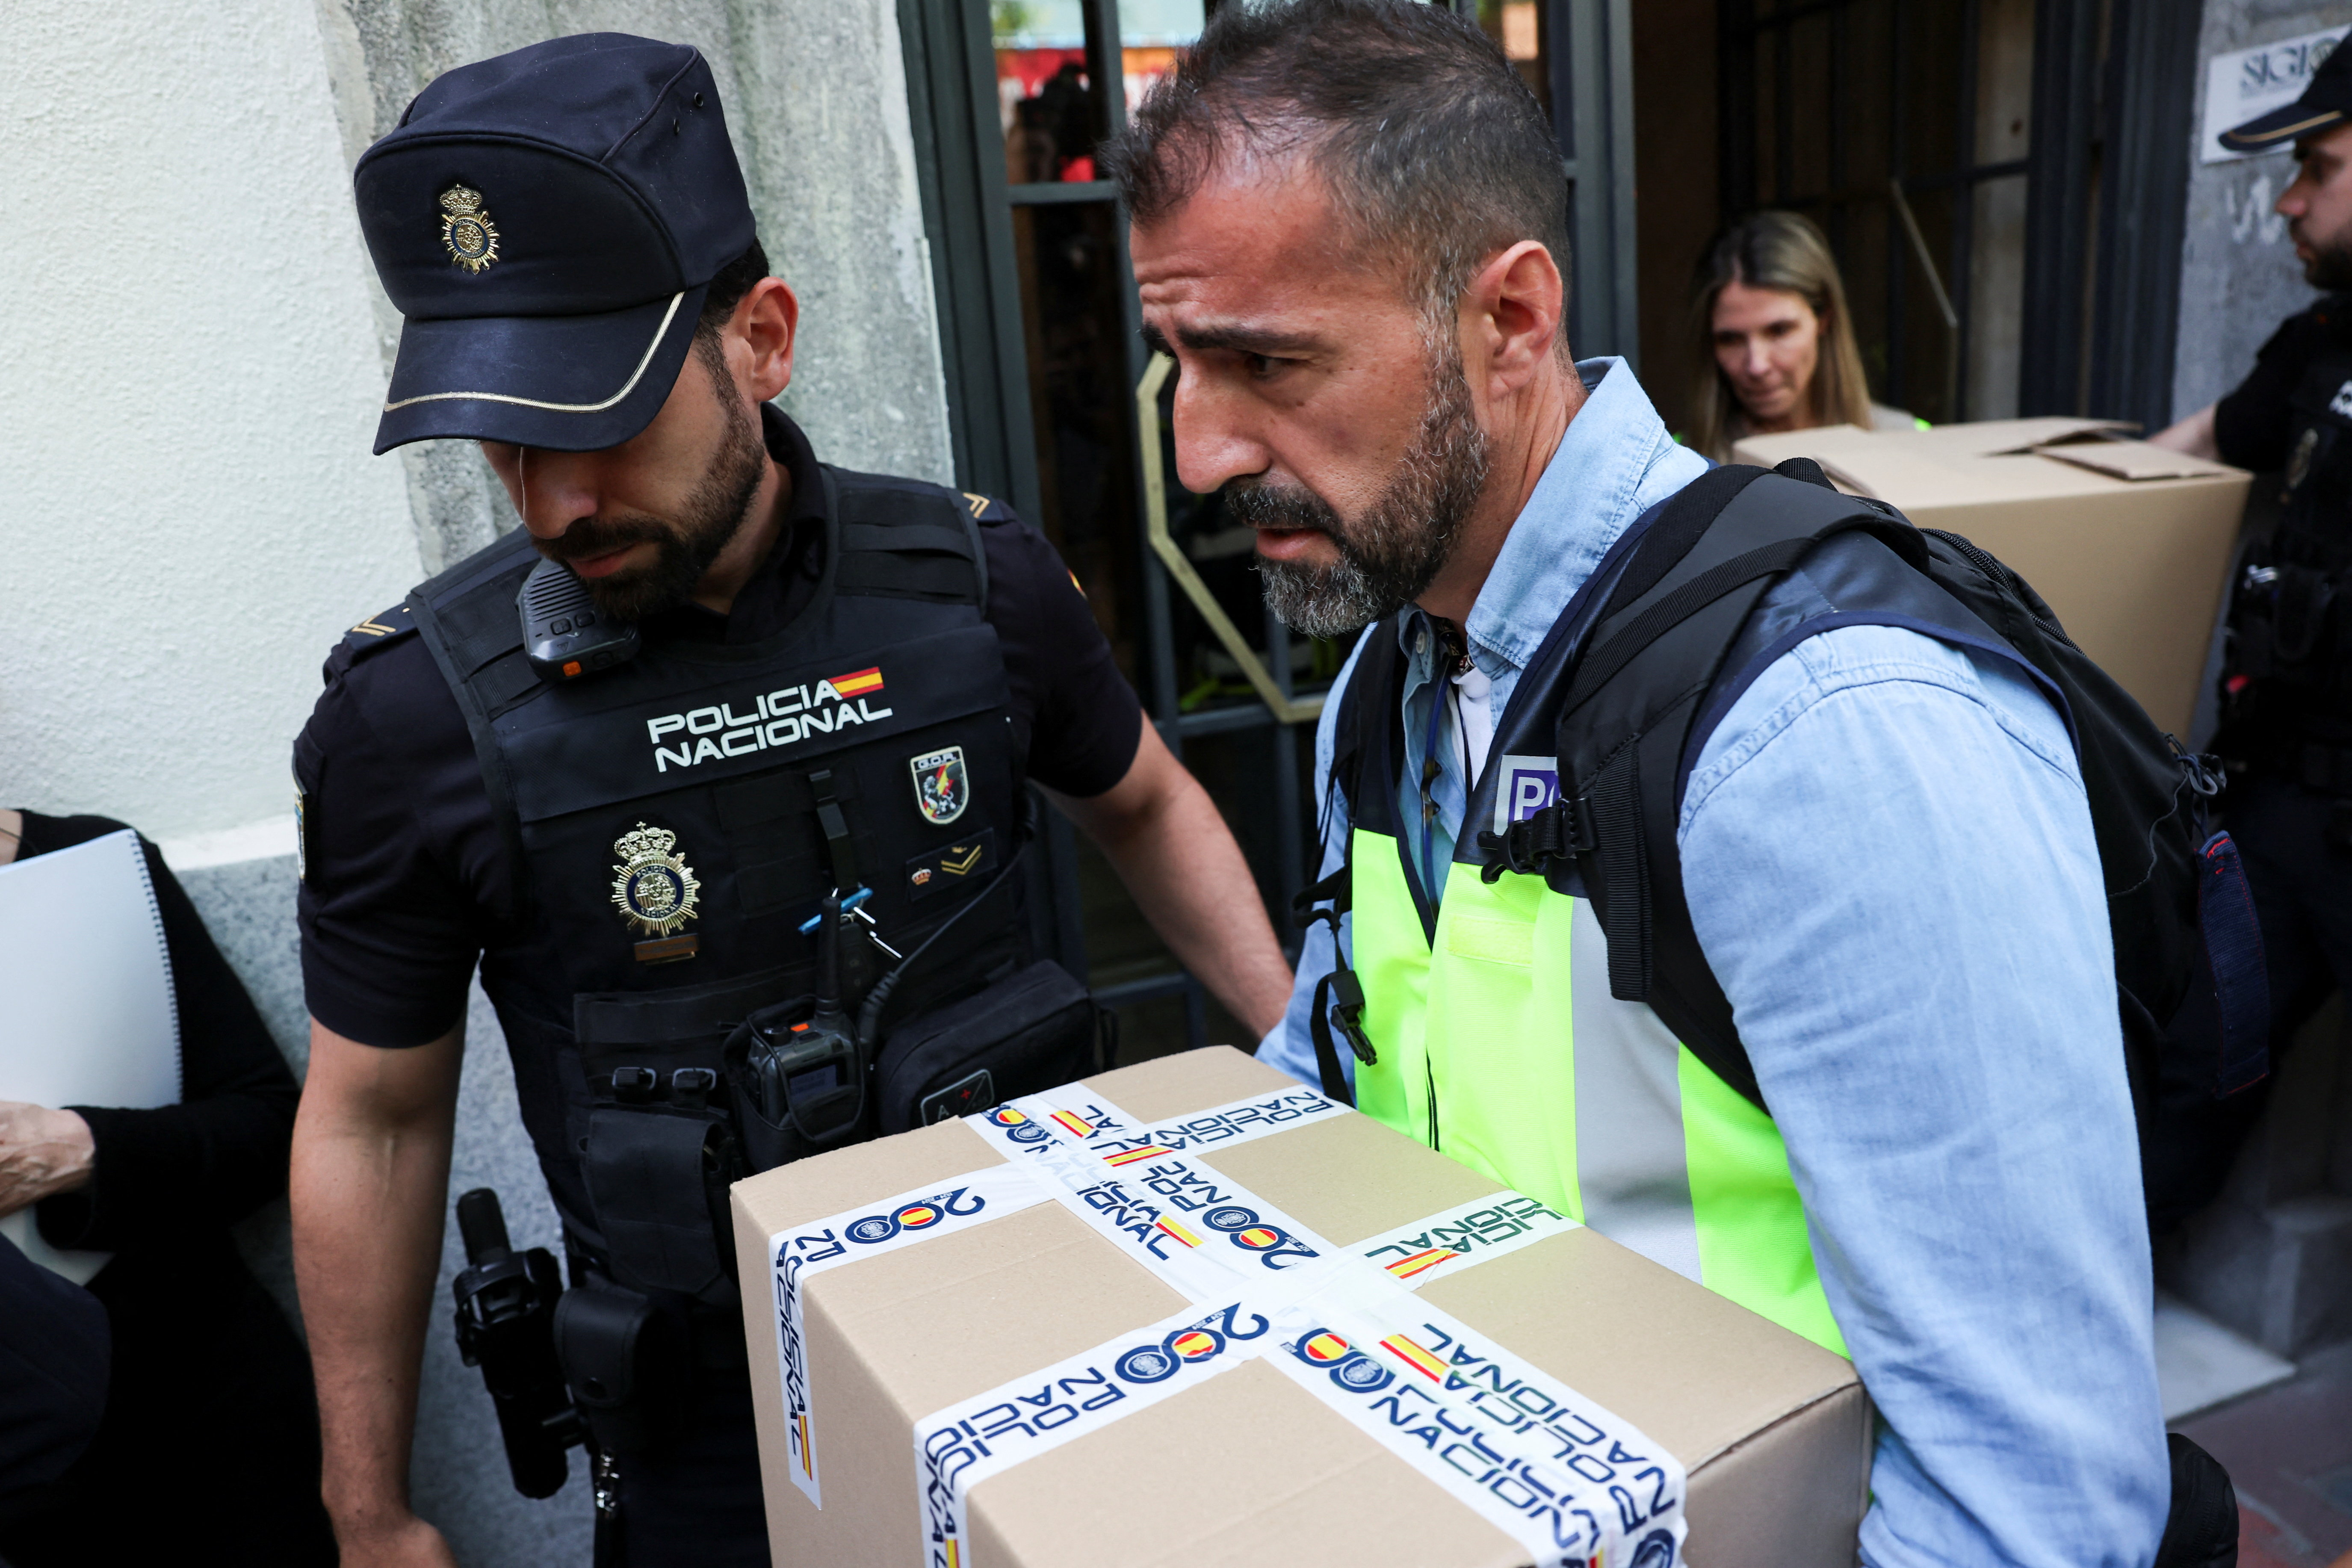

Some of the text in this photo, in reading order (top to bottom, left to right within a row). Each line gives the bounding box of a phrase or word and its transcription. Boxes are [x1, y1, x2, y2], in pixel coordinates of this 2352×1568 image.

[655, 699, 893, 772] NACIONAL
[1514, 777, 1562, 821] P
[1090, 1092, 1318, 1150] NACIONAL
[1364, 1198, 1542, 1257] CIONAL
[1422, 1323, 1675, 1517] NACIONAL
